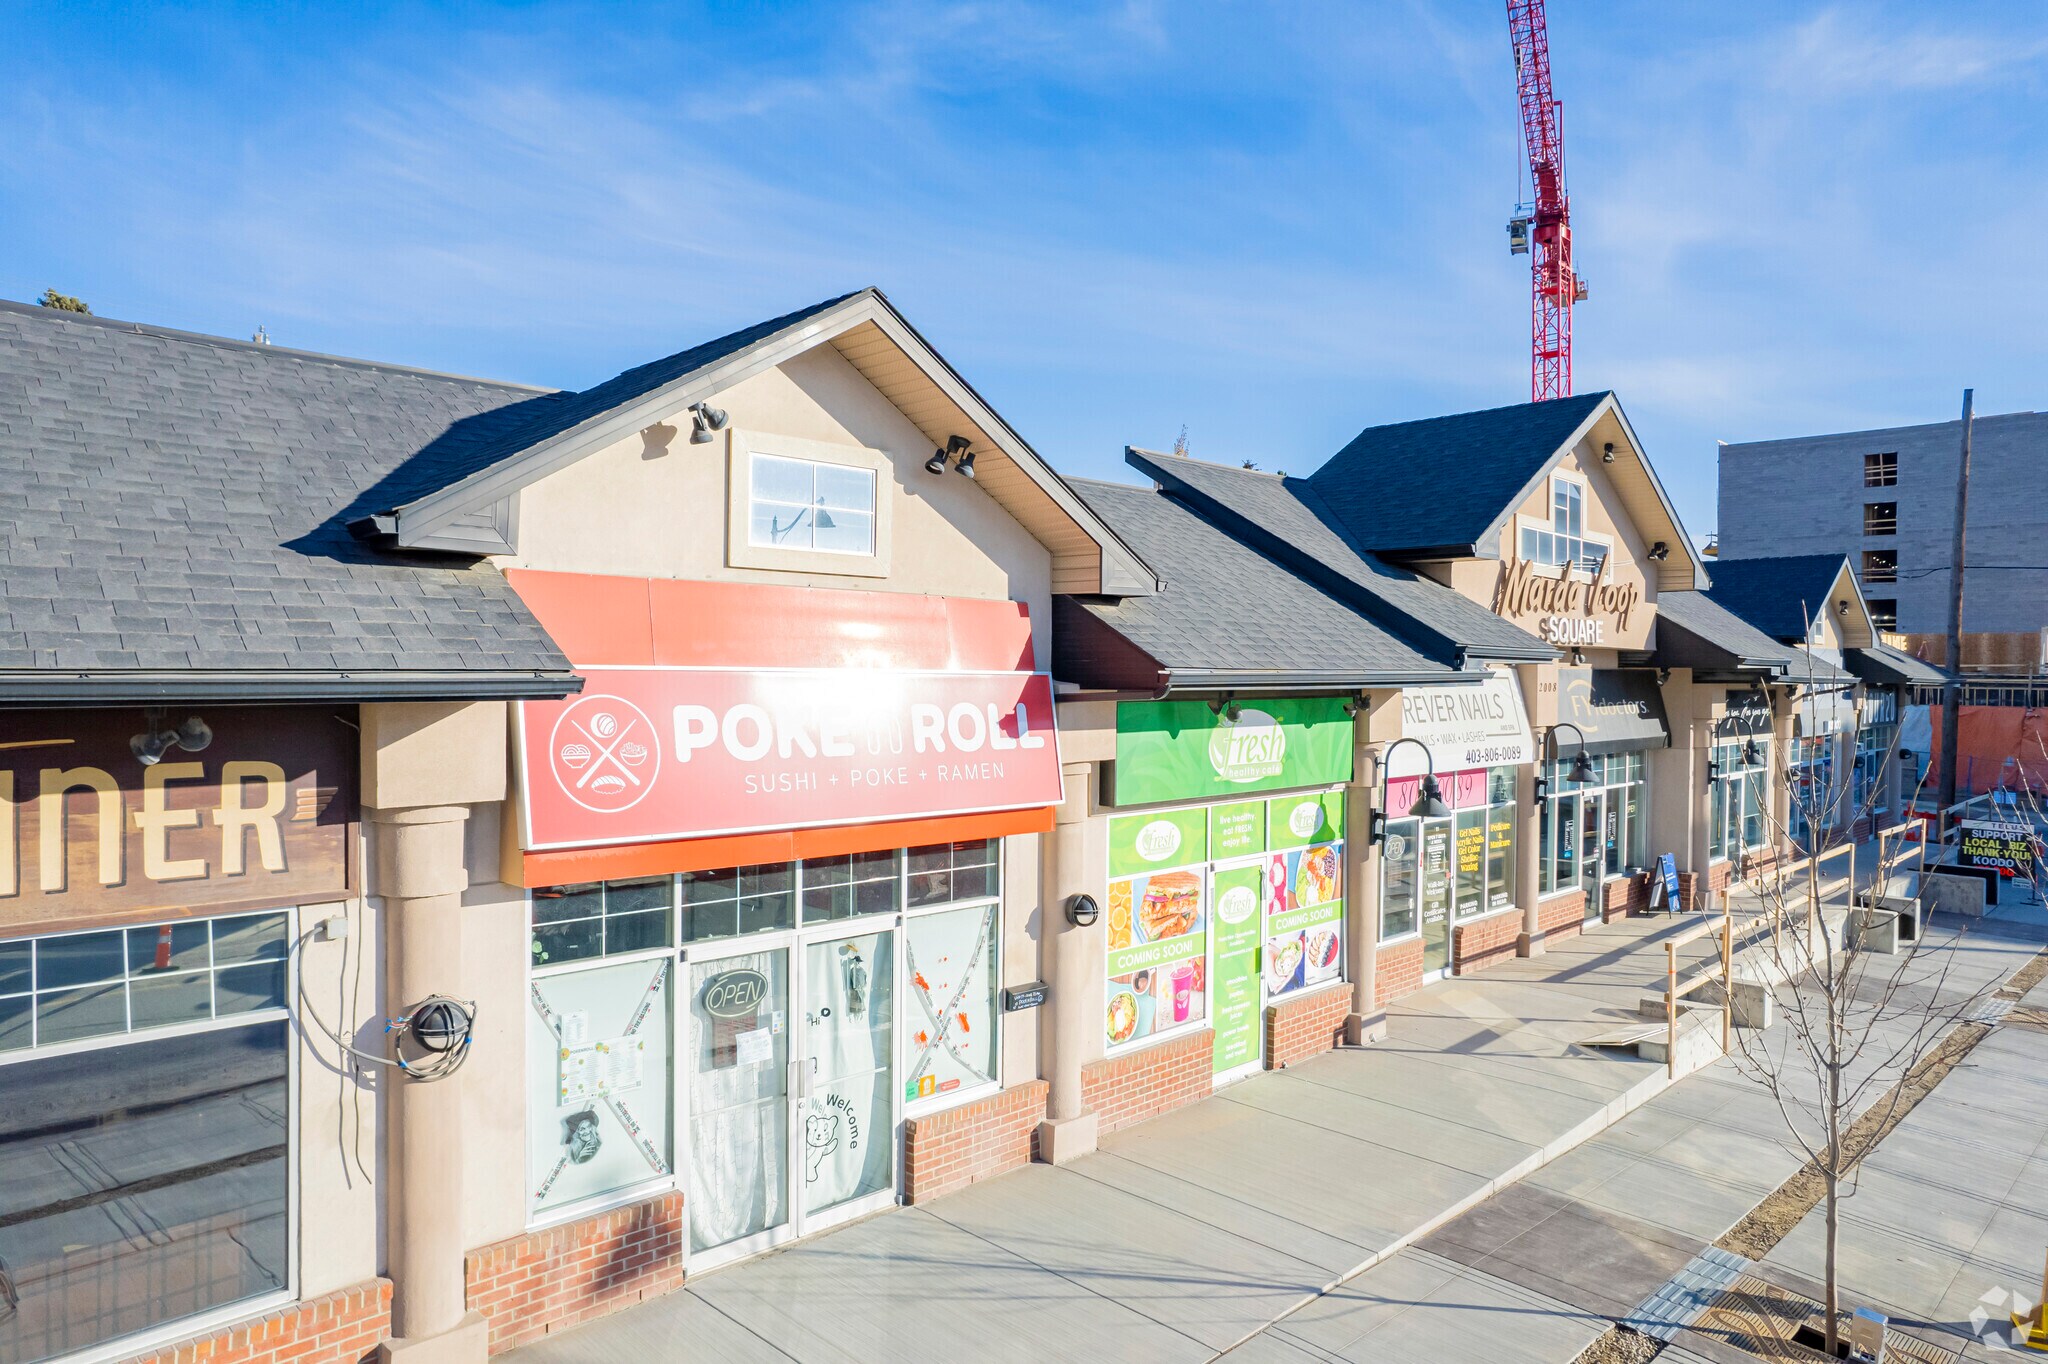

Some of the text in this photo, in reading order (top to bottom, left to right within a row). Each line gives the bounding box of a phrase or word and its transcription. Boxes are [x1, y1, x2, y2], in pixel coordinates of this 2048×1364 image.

[1500, 553, 1638, 631] Marda Loop
[1550, 616, 1604, 644] SQUARE
[1539, 683, 1557, 692] 2008
[1459, 693, 1504, 721] NAILS
[672, 704, 856, 763] POKE
[911, 702, 1045, 753] ROLL
[1415, 731, 1486, 747] NAILS WAX LASHES
[1222, 720, 1283, 776] fresh
[1466, 746, 1521, 764] 403-806-0089
[745, 772, 816, 794] SUSHI
[851, 767, 908, 787] POKE
[938, 762, 1004, 782] RAMEN
[1220, 815, 1231, 824] live
[1490, 822, 1511, 832] Pedicure
[1490, 839, 1511, 848] Manicure
[1965, 838, 2026, 851] LOCAL BIZ
[1972, 830, 2023, 841] SUPPORT
[1458, 845, 1480, 855] Gel Color
[1973, 856, 2014, 868] KOODO
[1276, 907, 1333, 930] COMING SOON!
[1118, 940, 1193, 968] COMING SOON!
[710, 980, 762, 1008] OPEN
[811, 1016, 820, 1026] Hi
[826, 1094, 859, 1150] Welcome
